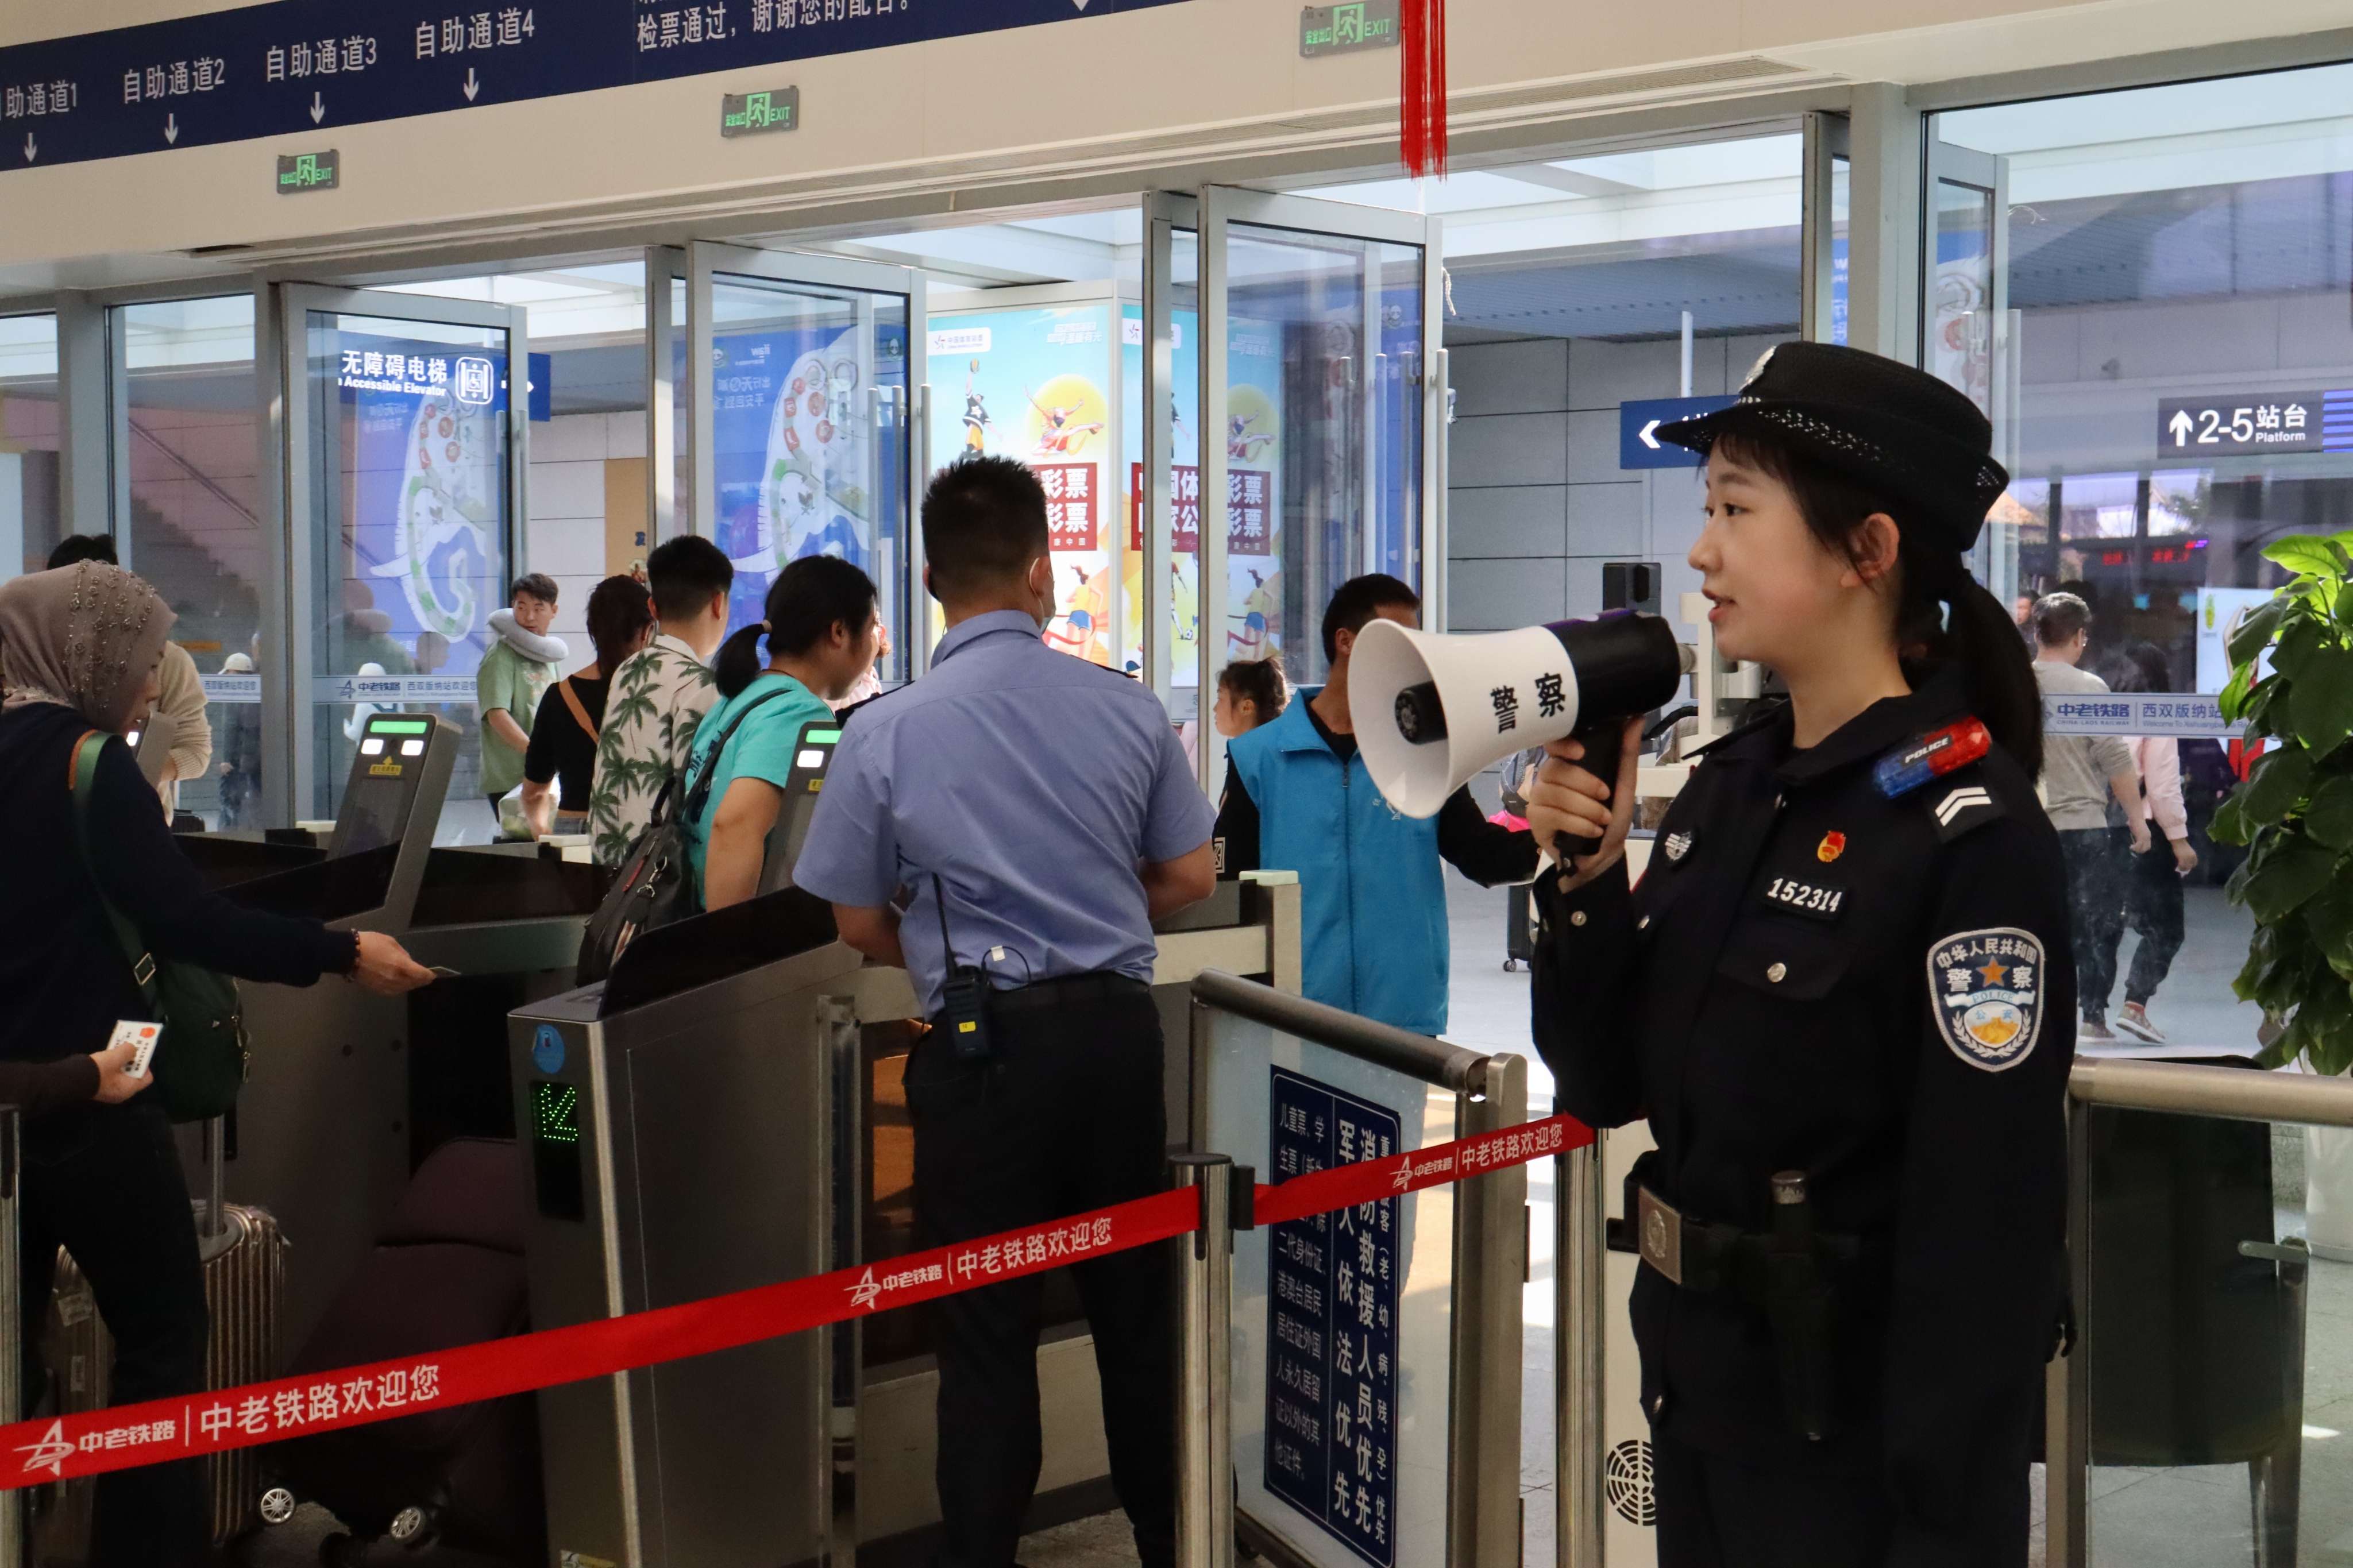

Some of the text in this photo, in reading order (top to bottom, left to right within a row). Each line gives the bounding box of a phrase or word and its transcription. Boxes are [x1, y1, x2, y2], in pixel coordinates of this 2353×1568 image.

[415, 8, 535, 60] 自助通道4
[1364, 18, 1391, 36] EXIT
[267, 37, 377, 82] 自助通道3
[123, 58, 225, 104] 自助通道2
[0, 80, 77, 120] 助通道1
[770, 106, 790, 121] EXIT
[342, 350, 448, 384] 无障碍电梯
[344, 376, 446, 396] Accessible Elevator
[2197, 404, 2307, 443] 2-5 站台
[2255, 431, 2306, 443] Platform
[358, 682, 400, 691] 中老铁路
[1490, 673, 1566, 734] 警察
[2057, 703, 2130, 717] 中老铁路
[1905, 737, 1949, 763] POLICE
[1767, 878, 1842, 912] 152314
[1936, 938, 2038, 969] 中华人民共和国
[1946, 965, 2032, 992] 警察
[1972, 991, 2014, 1004] POLICE
[1414, 1123, 1563, 1177] 中老铁路 中老铁路欢迎您
[883, 1217, 1112, 1291] 中老铁路 中老铁路欢迎您
[79, 1364, 440, 1454] 中老铁路 中老铁路欢迎您
